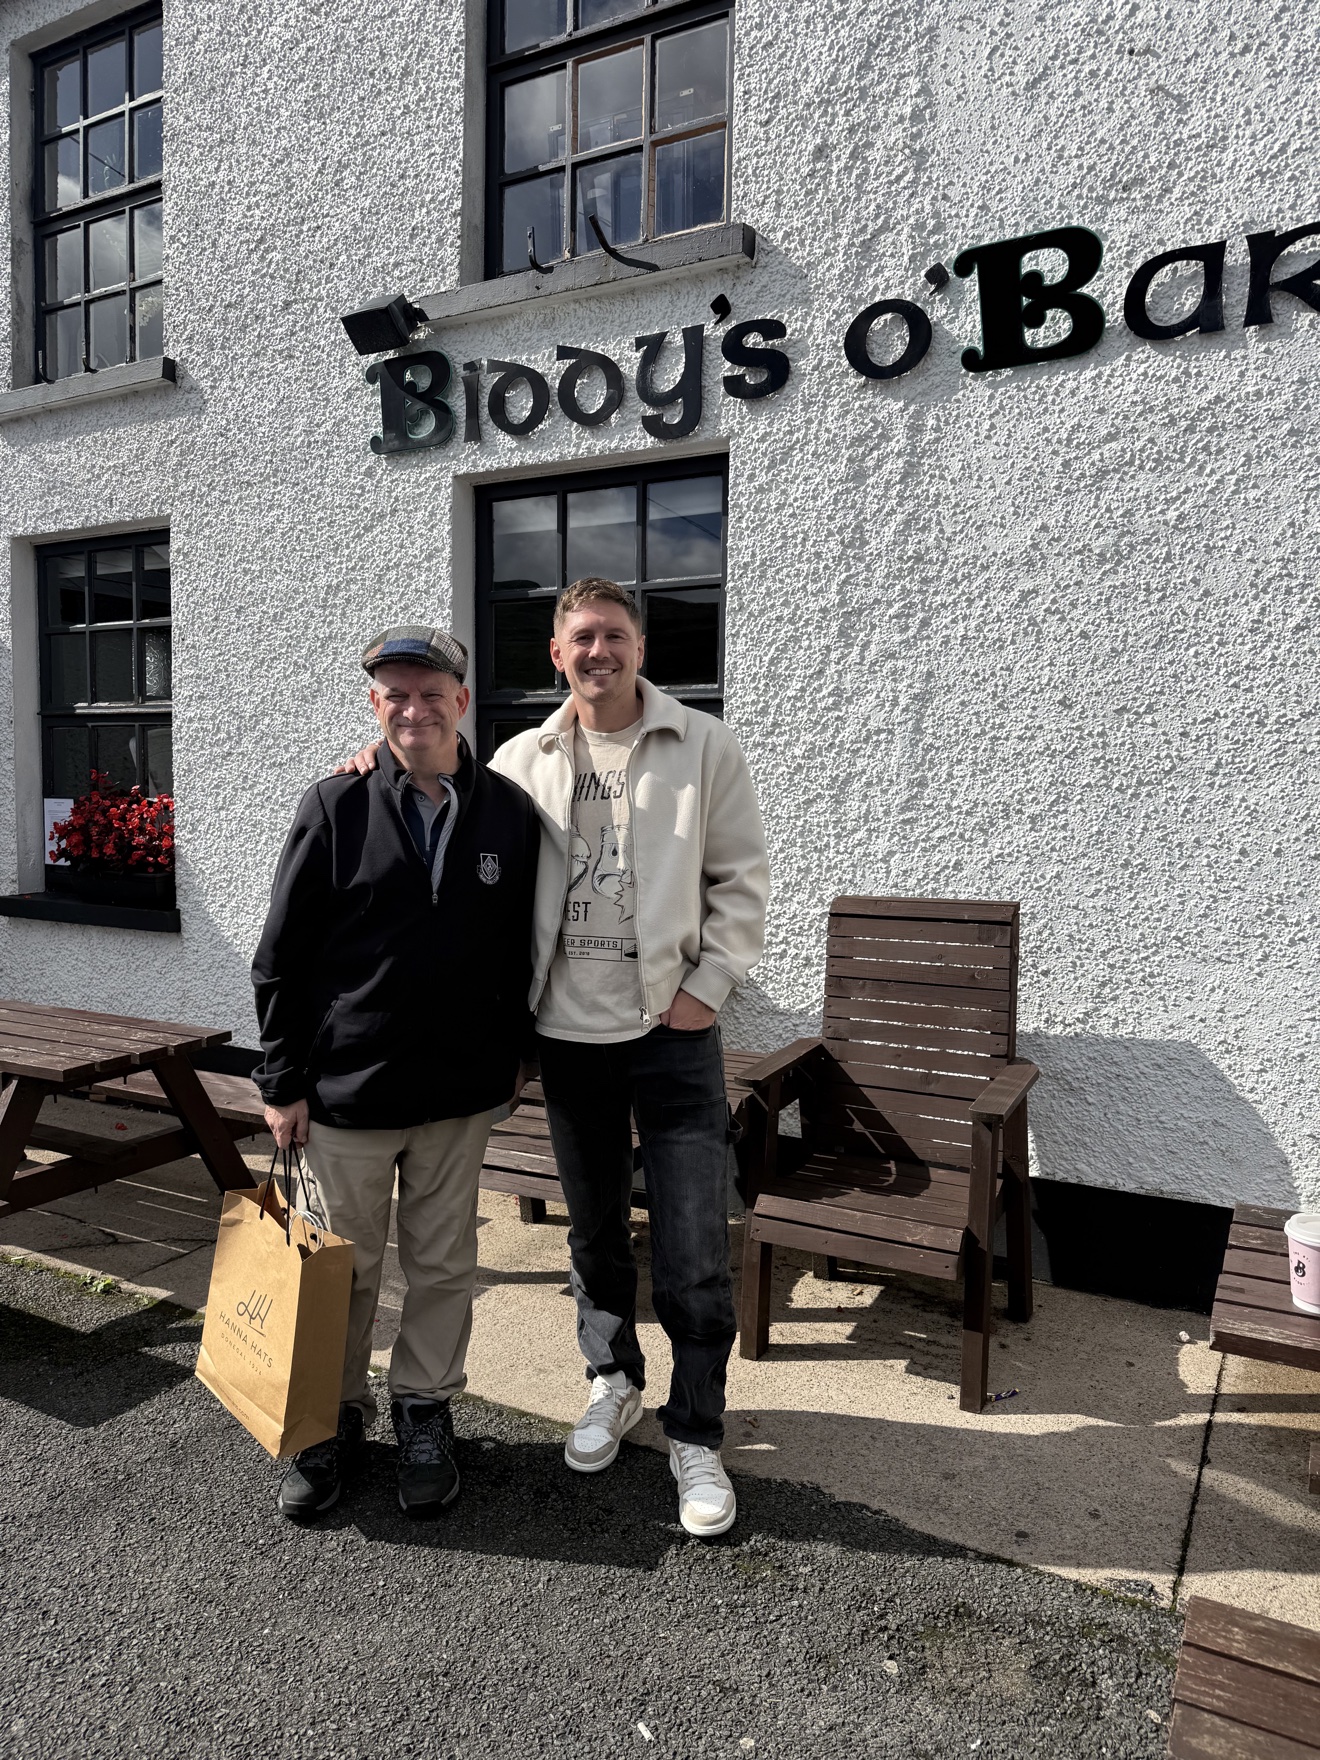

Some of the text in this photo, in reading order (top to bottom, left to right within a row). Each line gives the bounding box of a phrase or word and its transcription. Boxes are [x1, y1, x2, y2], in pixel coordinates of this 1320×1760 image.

[580, 939, 618, 949] SPORTS
[219, 1311, 273, 1368] HANNA HATS
[220, 1332, 246, 1361] DONEGAL
